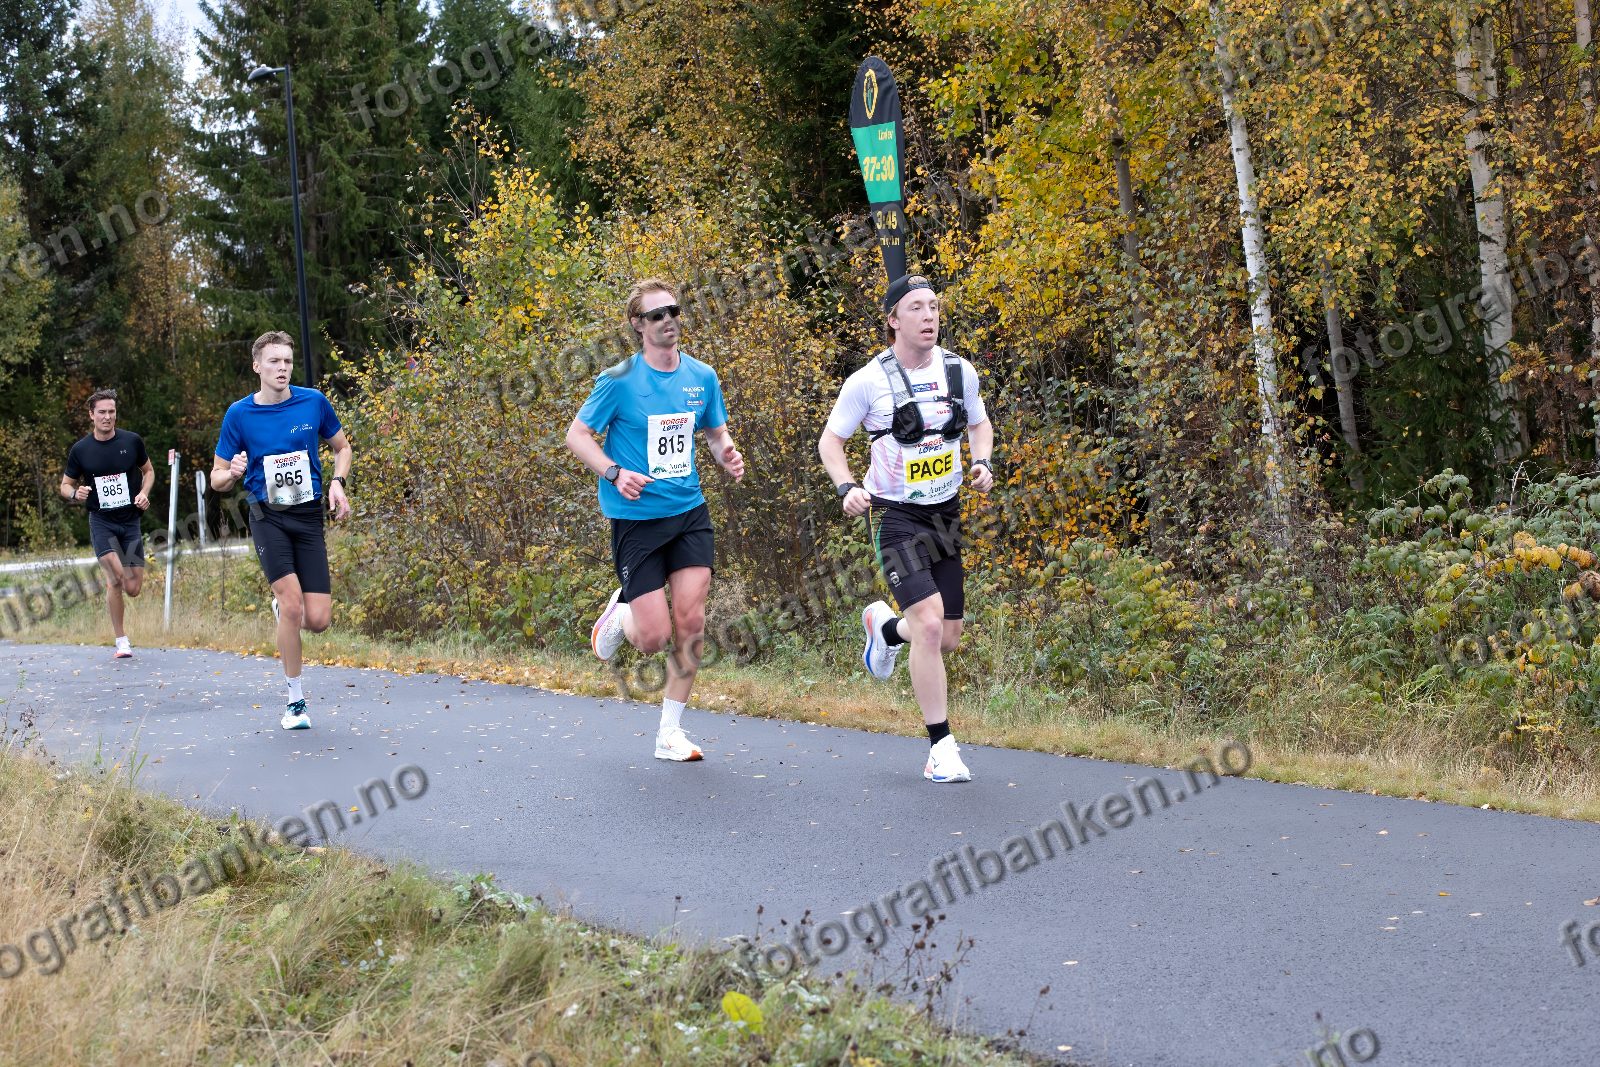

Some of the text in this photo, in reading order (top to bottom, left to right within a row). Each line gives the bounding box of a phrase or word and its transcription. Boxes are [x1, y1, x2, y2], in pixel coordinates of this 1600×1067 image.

[863, 155, 895, 181] 37:30
[876, 210, 897, 230] 3:45
[660, 417, 688, 425] NORGES
[658, 434, 685, 456] 815
[910, 453, 952, 480] PACE
[274, 469, 303, 488] 965
[102, 484, 122, 497] 985
